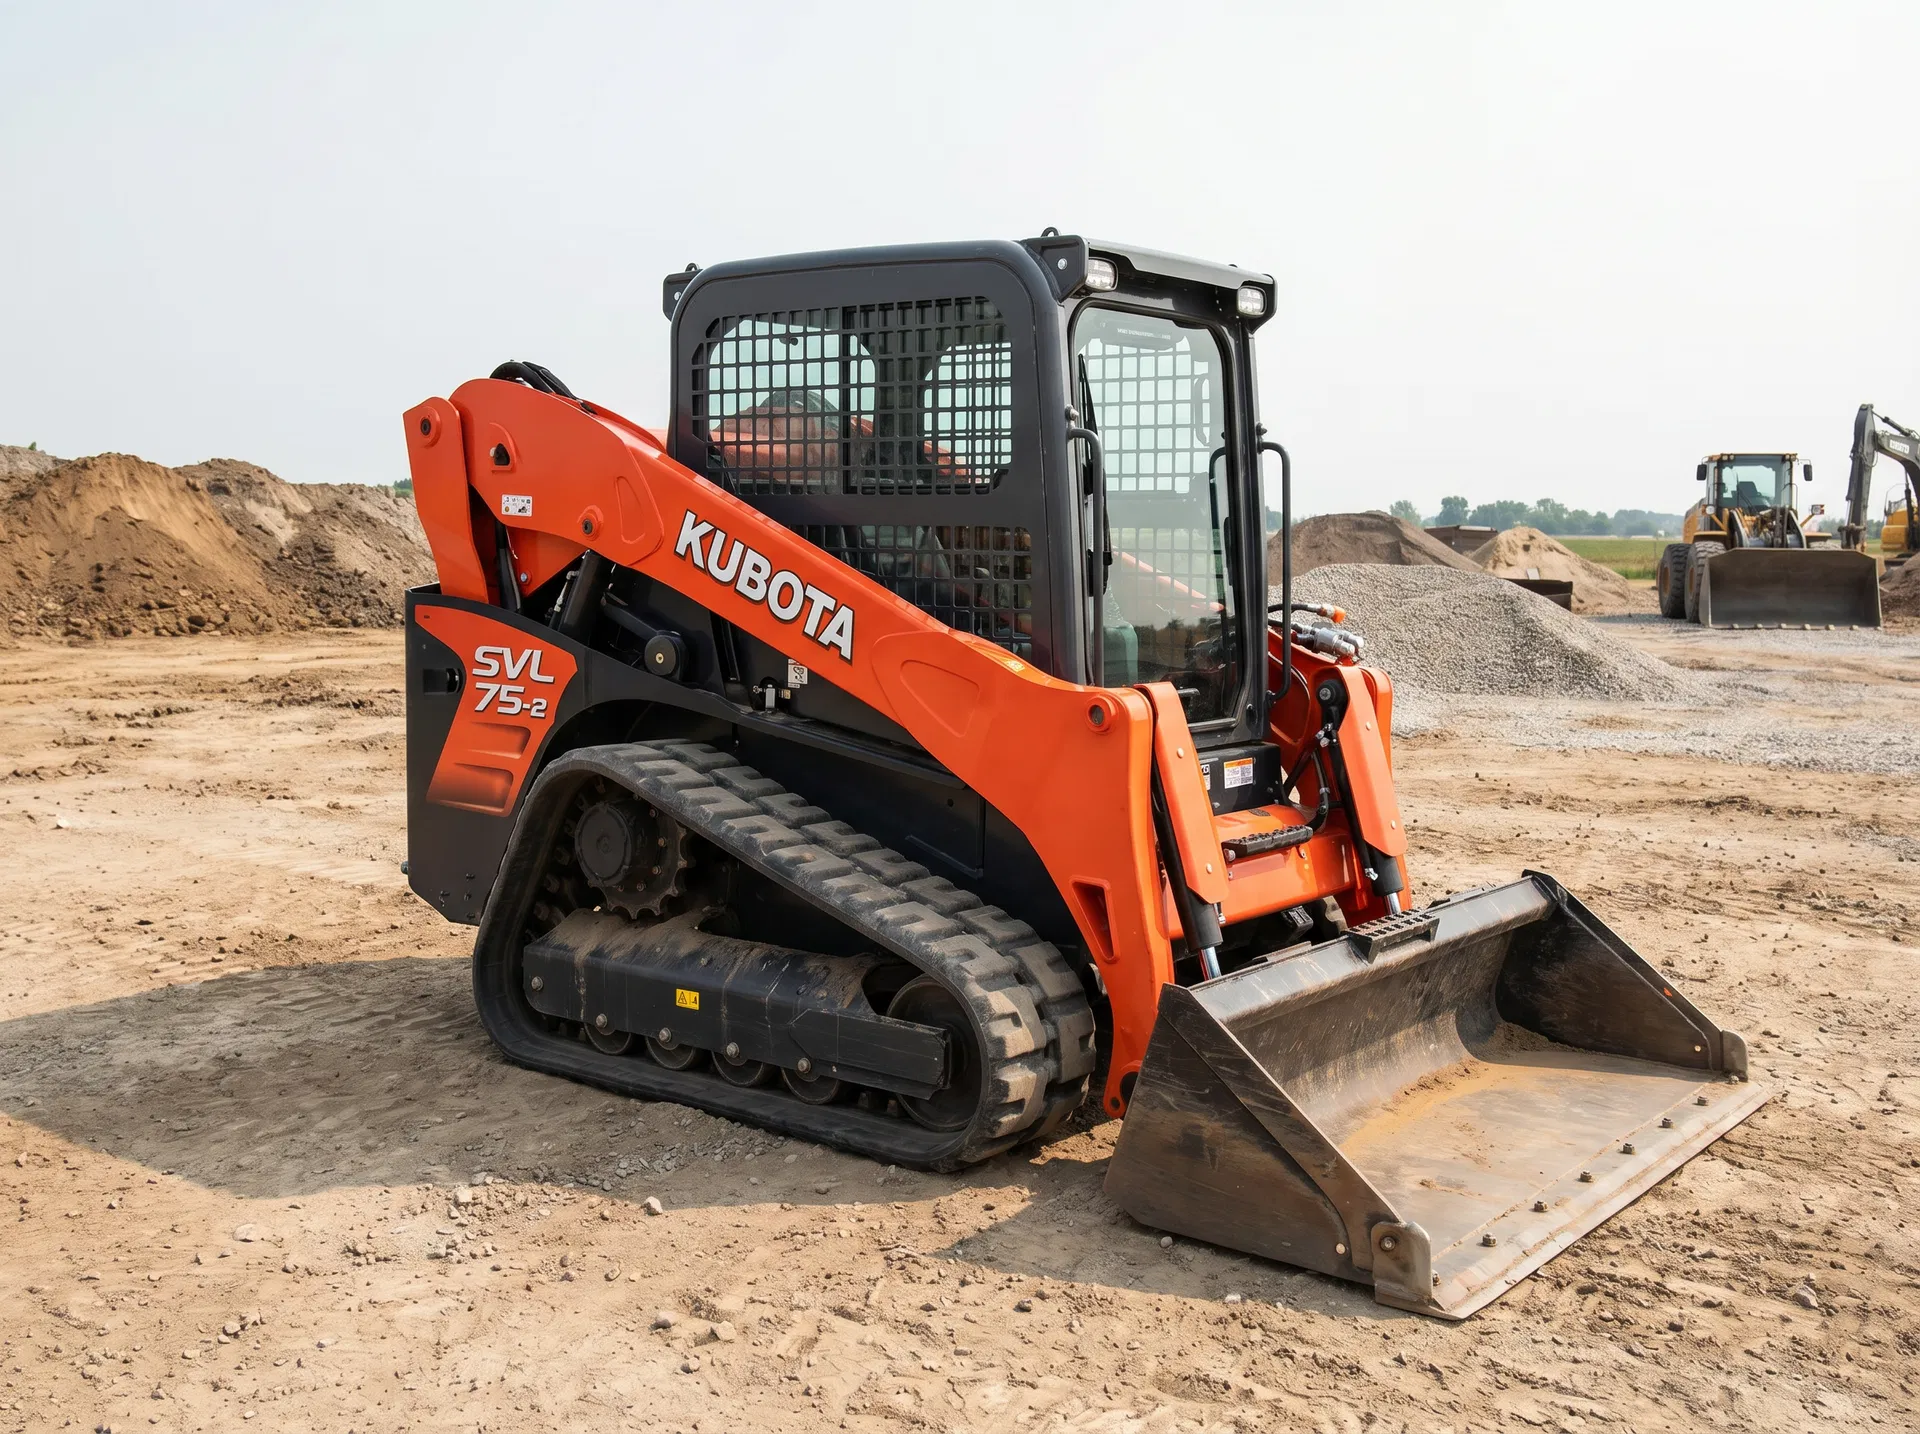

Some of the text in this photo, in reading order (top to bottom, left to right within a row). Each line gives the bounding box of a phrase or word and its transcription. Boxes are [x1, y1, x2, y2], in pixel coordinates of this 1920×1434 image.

[674, 509, 854, 664] KUBOTA
[472, 645, 555, 683] SVL
[474, 682, 547, 718] 75-2
